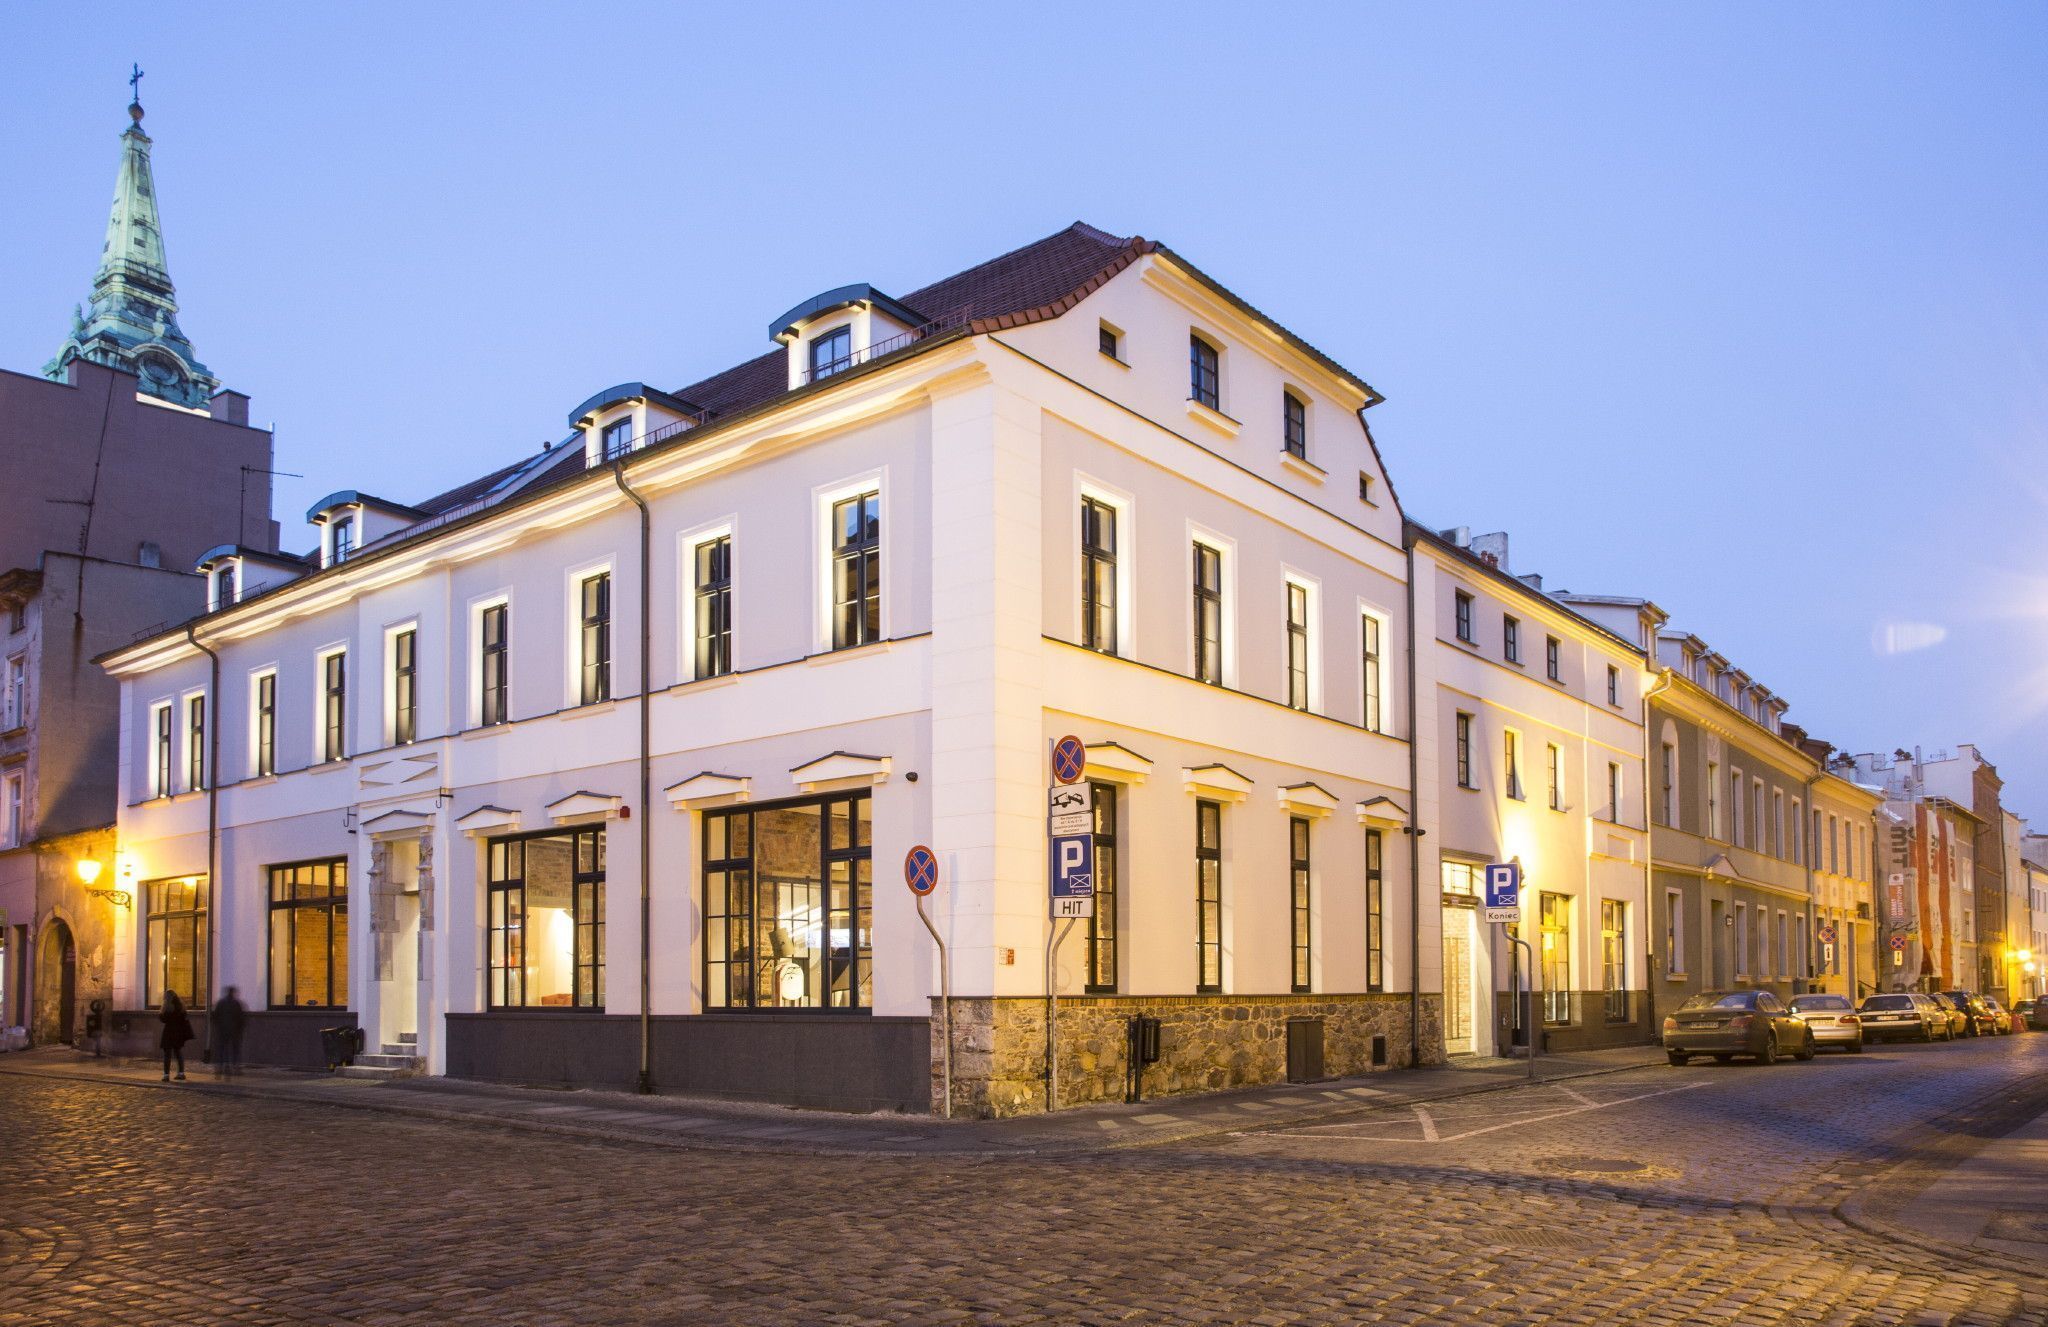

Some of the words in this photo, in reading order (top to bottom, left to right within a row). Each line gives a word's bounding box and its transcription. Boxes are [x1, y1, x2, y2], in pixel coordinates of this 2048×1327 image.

[1060, 840, 1083, 879] P
[1493, 867, 1512, 895] P
[1062, 900, 1083, 915] HIT
[1488, 912, 1518, 920] Koniec
